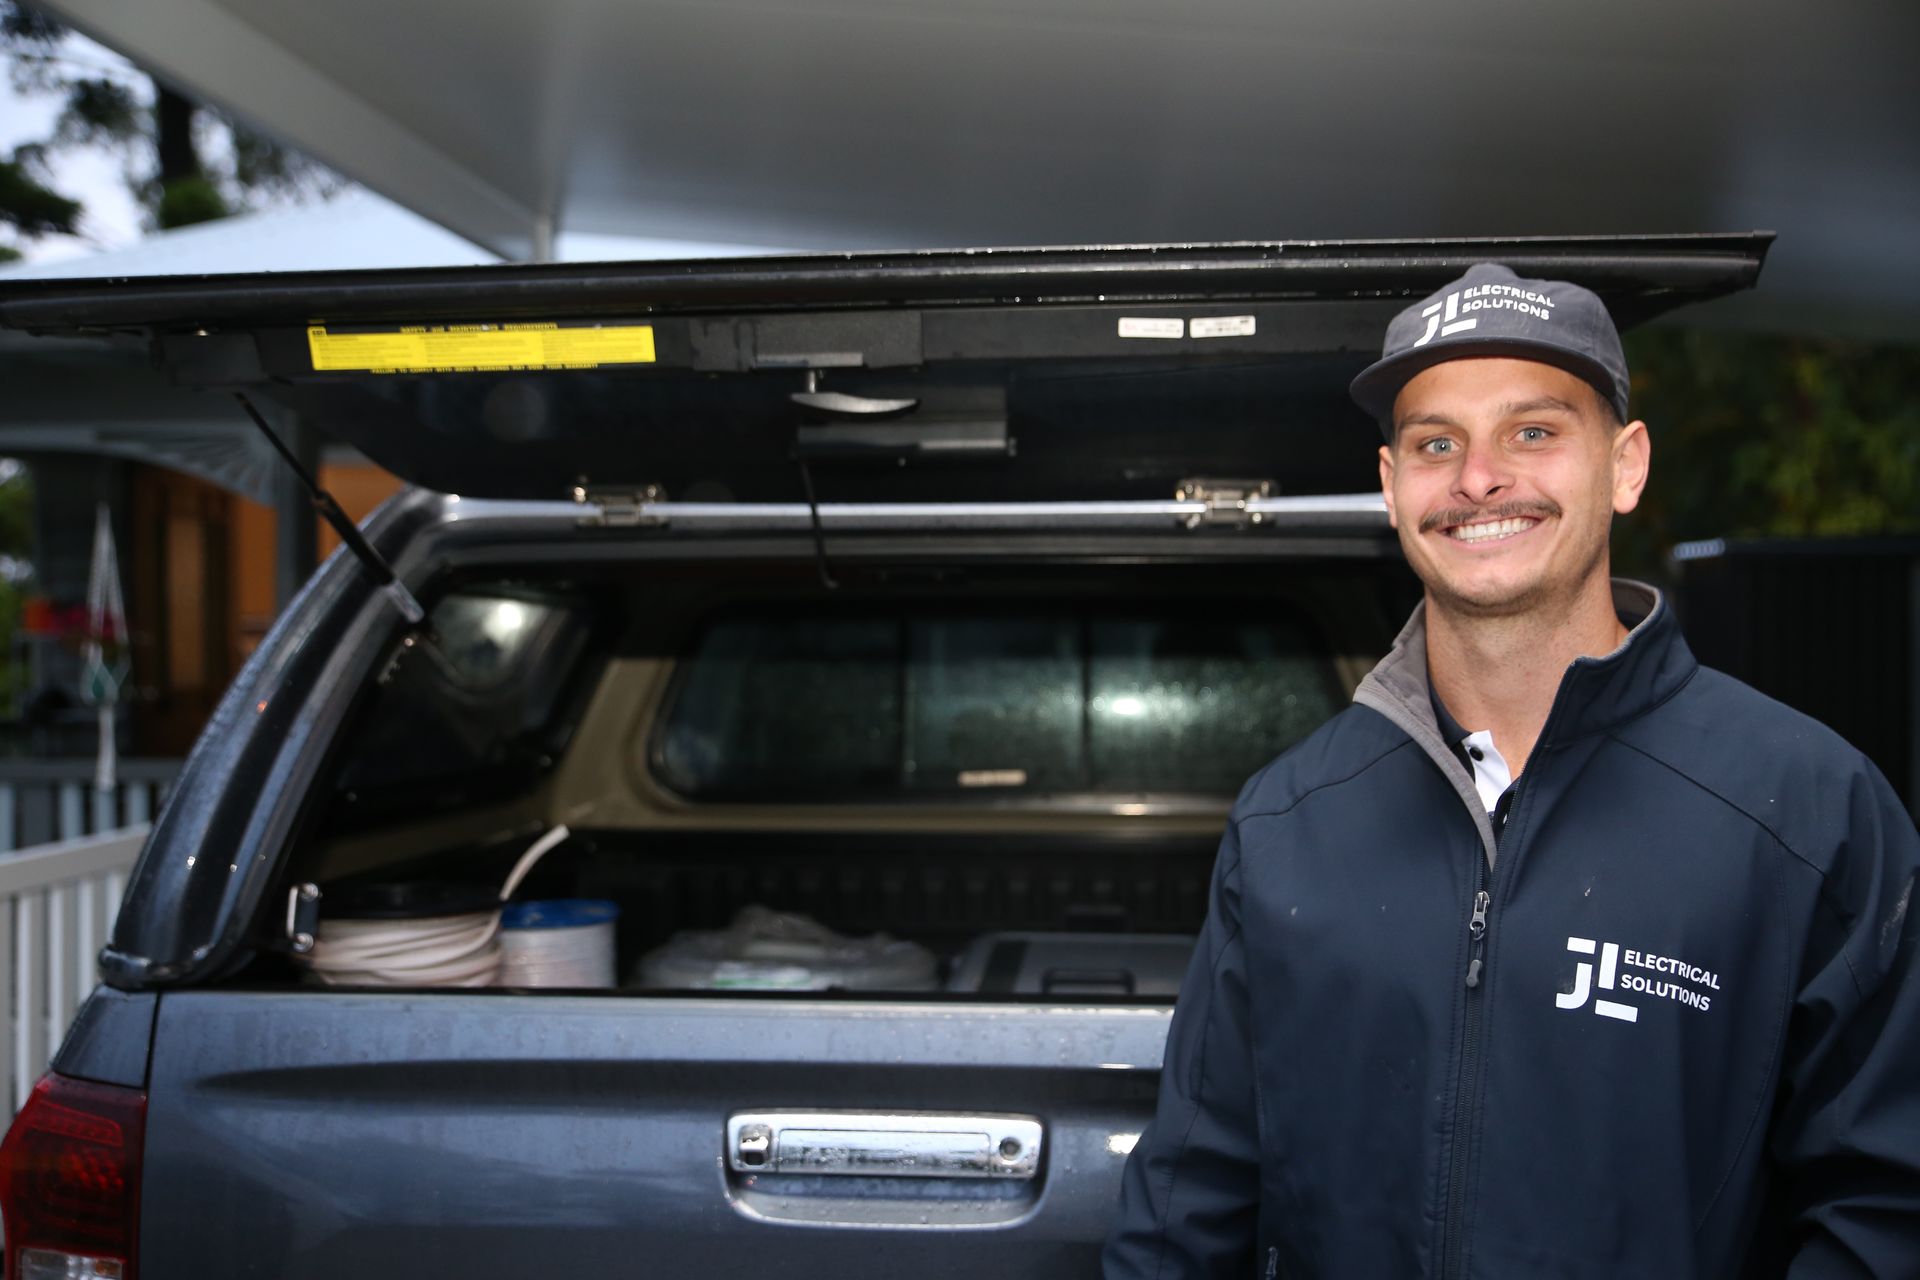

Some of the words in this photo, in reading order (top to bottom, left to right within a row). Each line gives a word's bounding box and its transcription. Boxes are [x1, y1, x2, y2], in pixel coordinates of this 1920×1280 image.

[1462, 298, 1550, 320] SOLUTIONS
[1463, 284, 1555, 308] ELECTRICAL
[1623, 949, 1721, 990] ELECTRICAL
[1620, 974, 1711, 1011] SOLUTIONS
